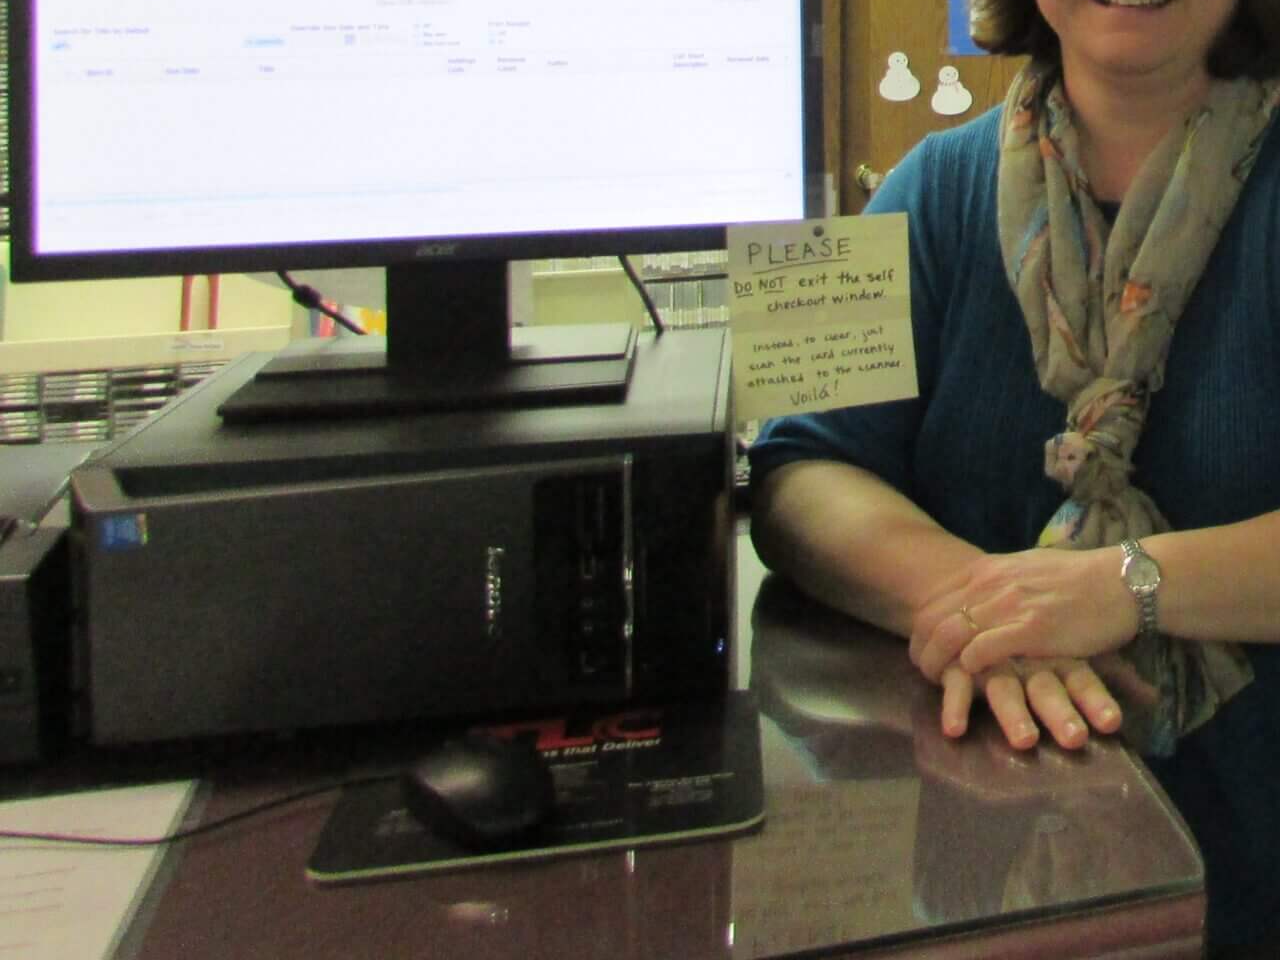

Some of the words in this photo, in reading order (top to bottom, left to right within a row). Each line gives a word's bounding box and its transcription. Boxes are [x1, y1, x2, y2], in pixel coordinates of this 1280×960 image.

[746, 237, 852, 266] PLEASE
[734, 280, 753, 295] DO
[758, 276, 786, 290] NOT
[798, 274, 828, 288] exit
[837, 271, 861, 285] the
[866, 268, 896, 283] self
[767, 295, 826, 313] checkout
[804, 335, 816, 345] to
[861, 325, 885, 343] just
[748, 360, 776, 371] scan
[782, 355, 801, 366] the
[810, 349, 835, 363] card
[841, 342, 896, 358] currently
[746, 373, 805, 388] attached
[816, 369, 830, 379] to
[834, 364, 852, 375] the
